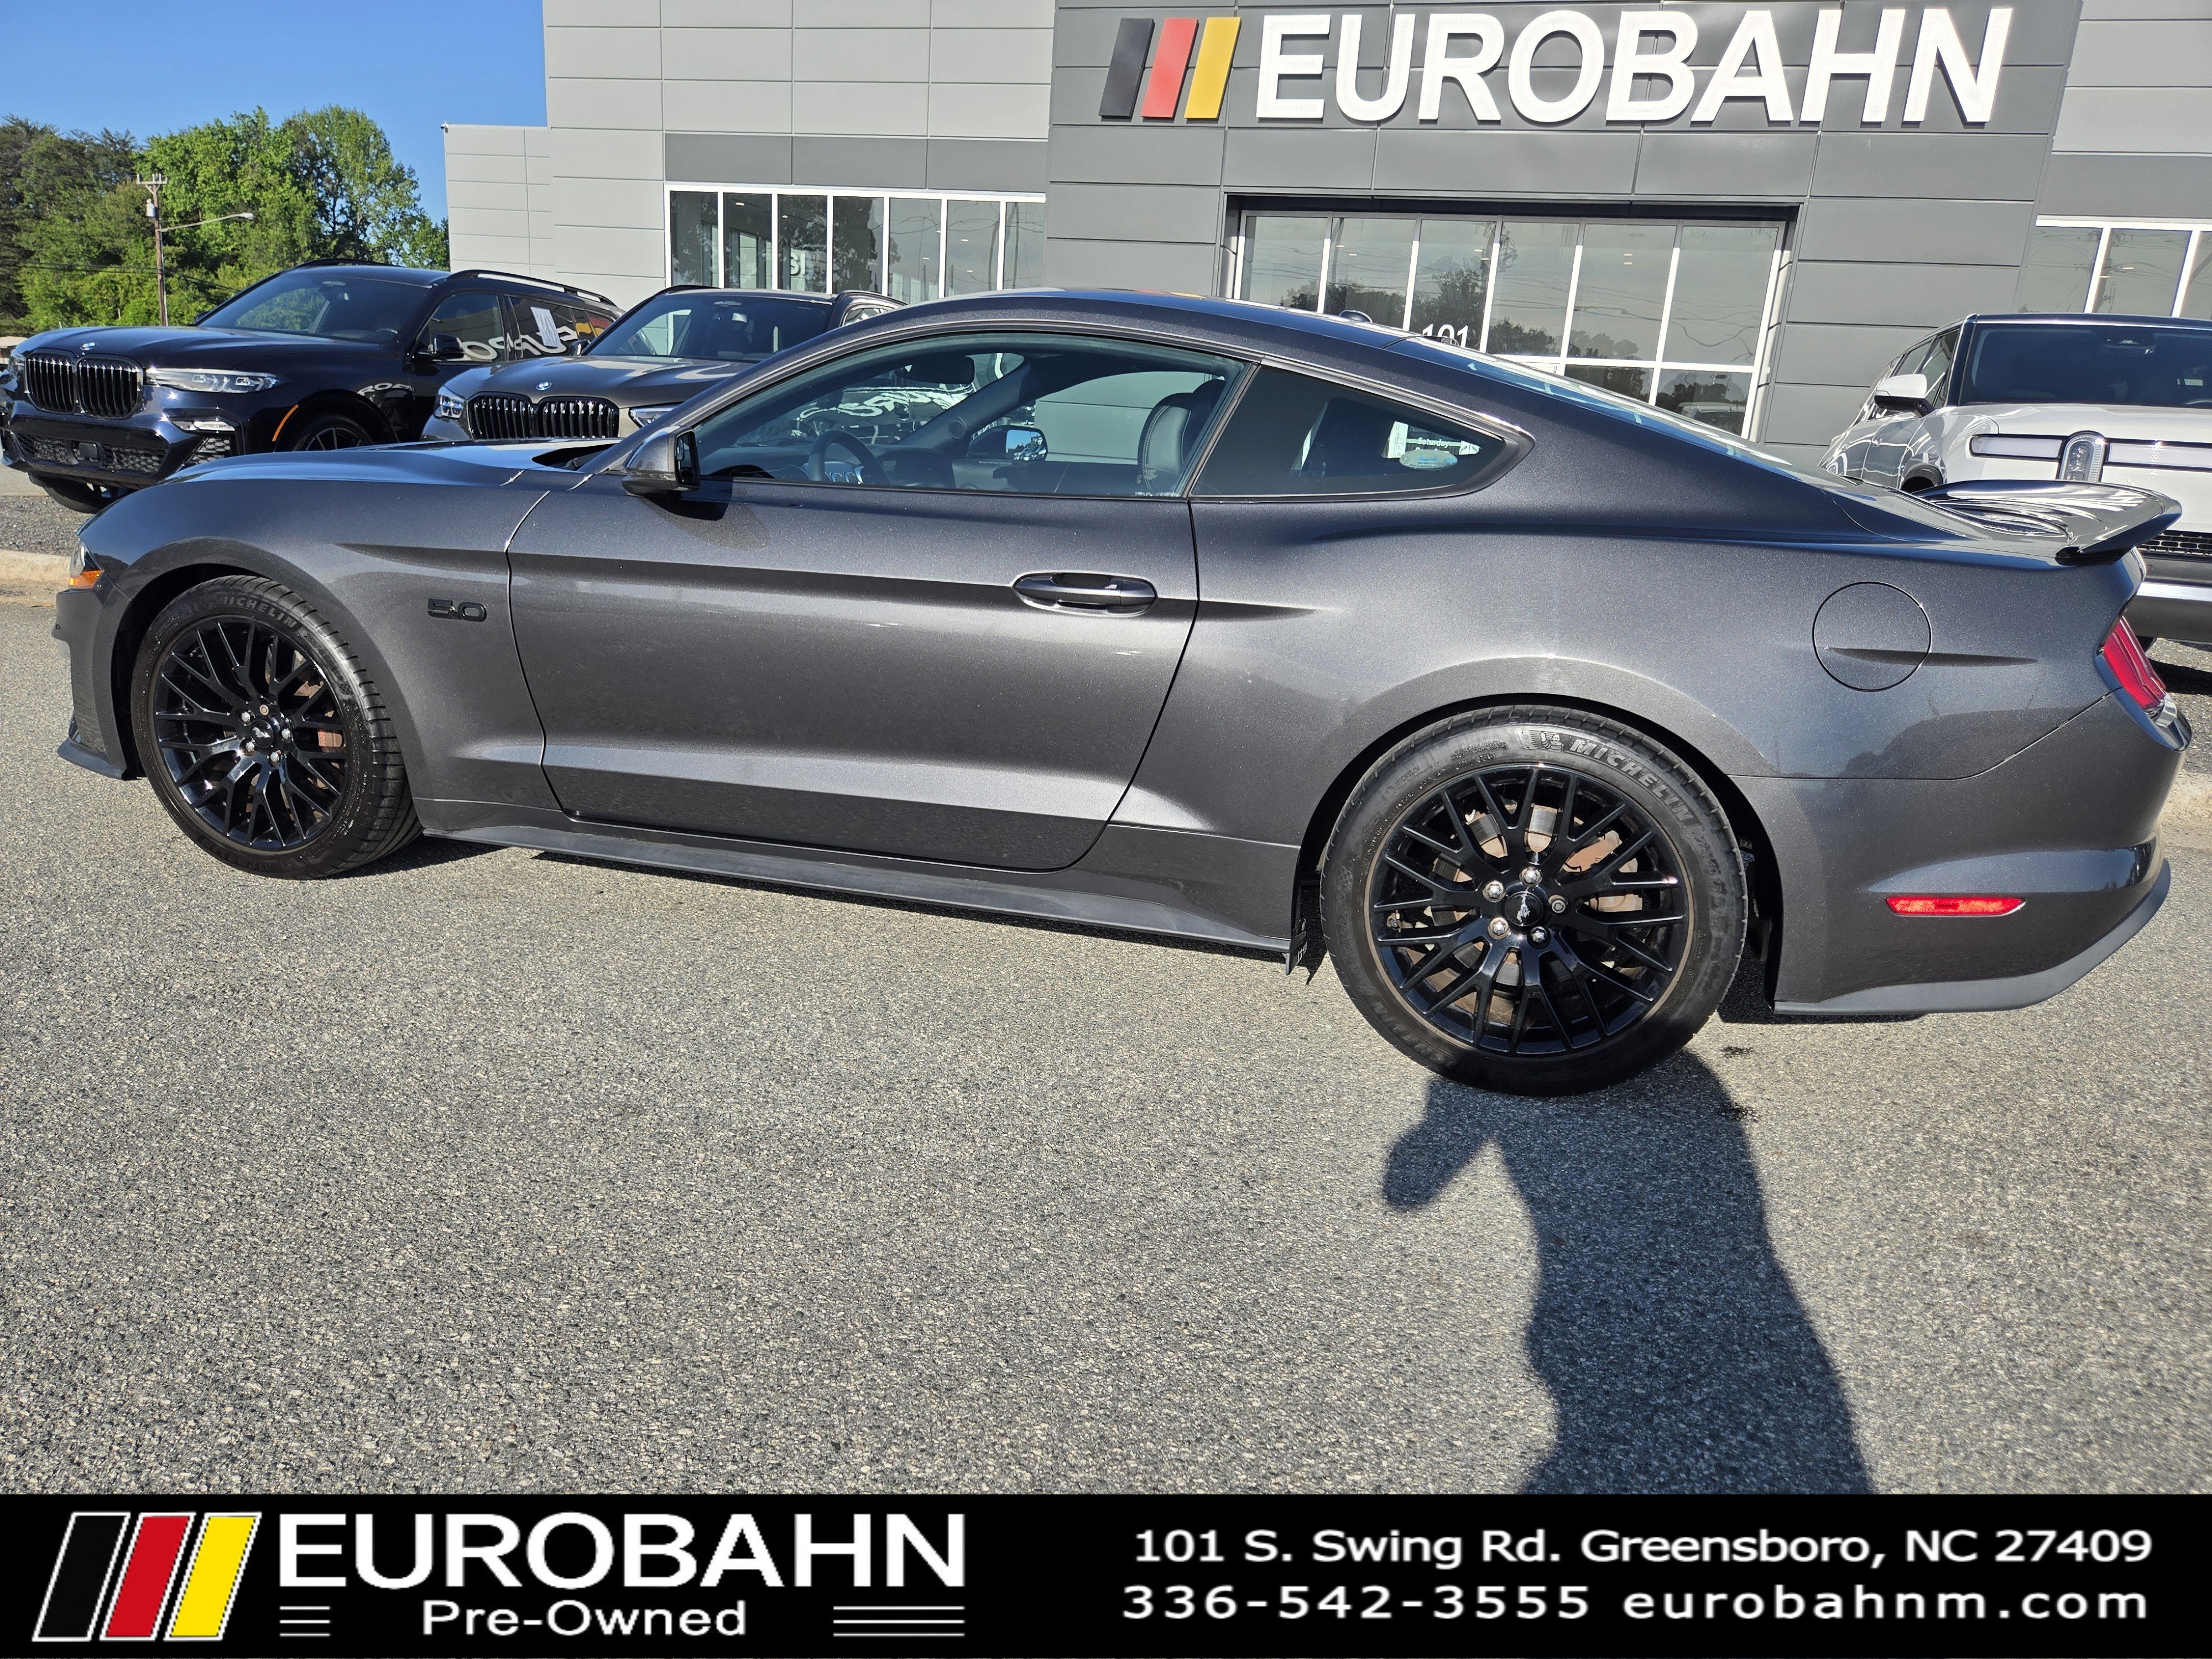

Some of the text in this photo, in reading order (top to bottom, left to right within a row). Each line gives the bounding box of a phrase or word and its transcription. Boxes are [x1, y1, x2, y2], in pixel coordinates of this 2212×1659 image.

[1255, 8, 2013, 122] EUROBAHN
[1422, 324, 1468, 347] 101
[1417, 437, 1450, 448] Saturday
[427, 598, 487, 622] 5.0
[1569, 739, 1694, 822] MICHELIN
